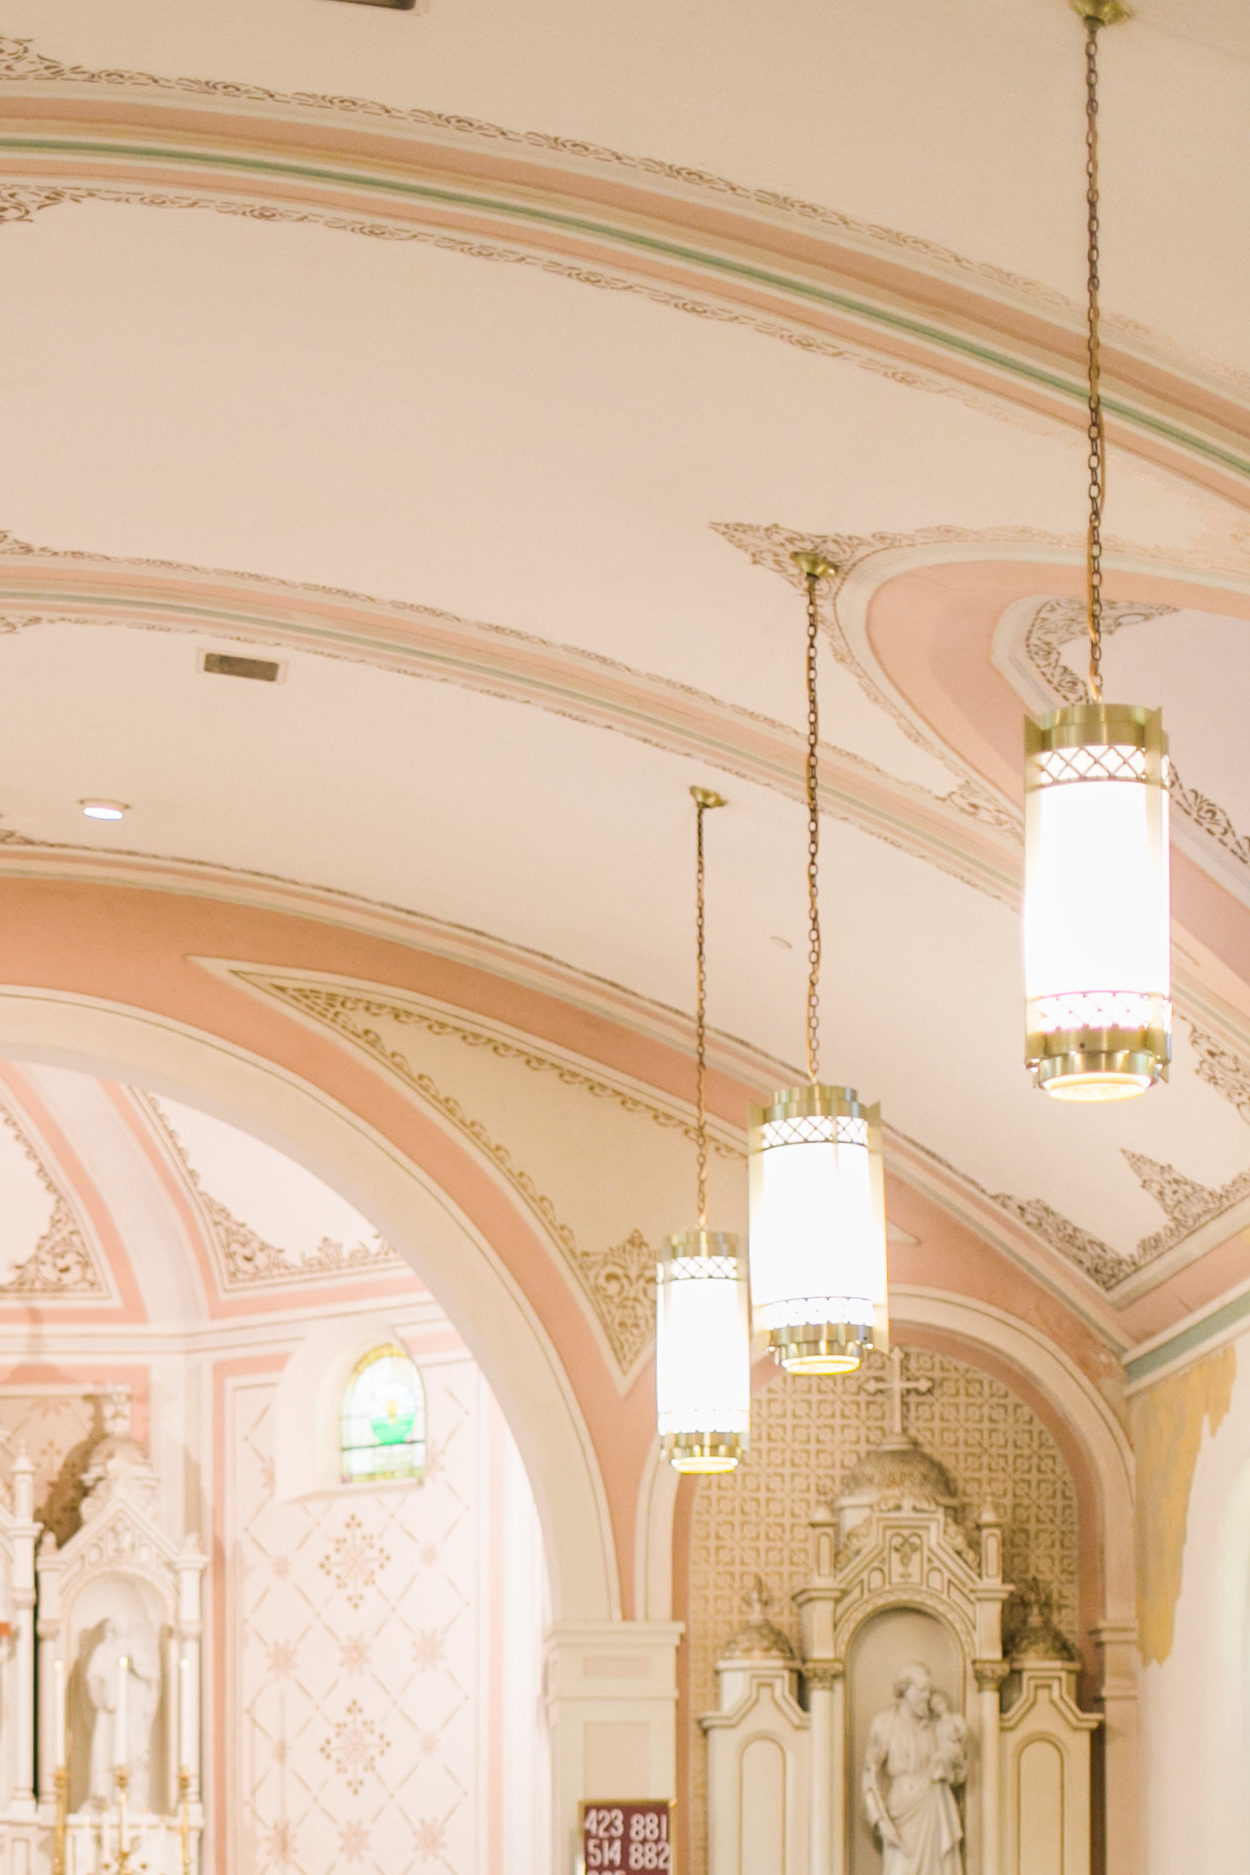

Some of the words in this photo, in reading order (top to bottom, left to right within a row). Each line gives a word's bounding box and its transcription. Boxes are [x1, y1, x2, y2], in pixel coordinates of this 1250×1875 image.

[584, 1808, 624, 1838] 423
[630, 1812, 668, 1842] 881
[587, 1838, 622, 1867] 514
[628, 1841, 671, 1870] 882
